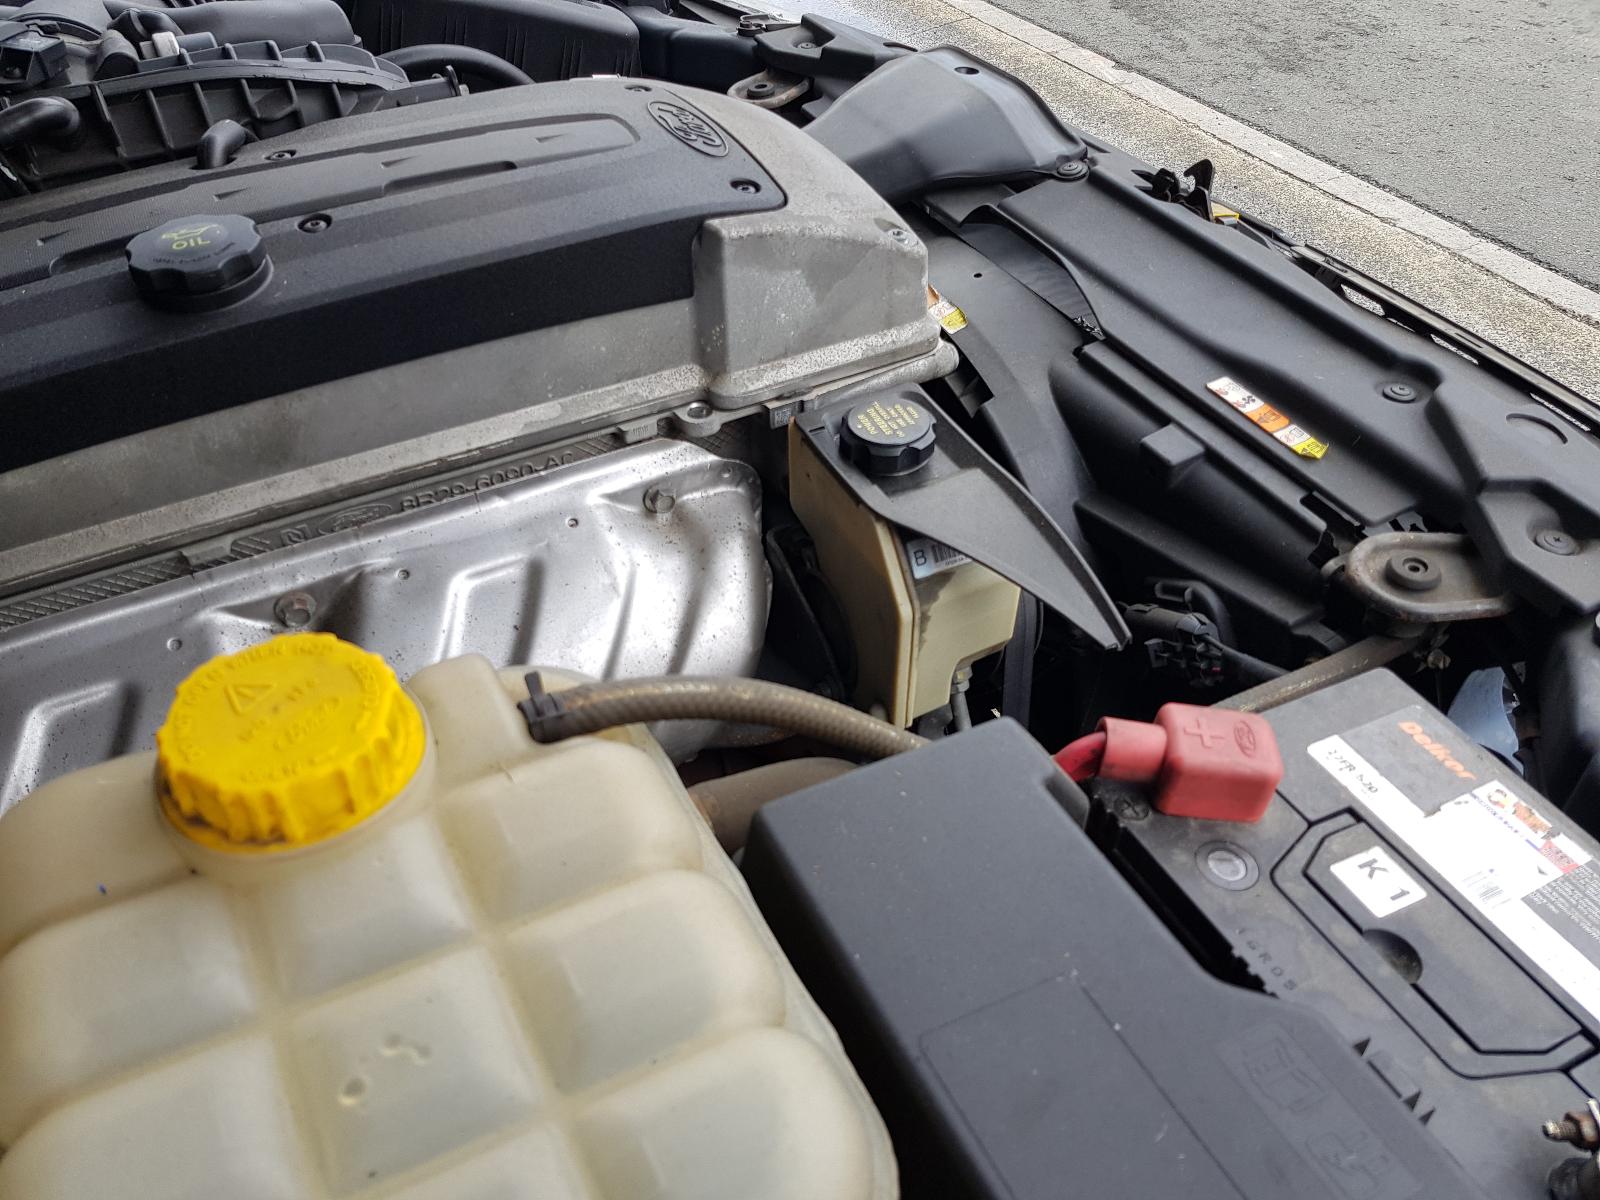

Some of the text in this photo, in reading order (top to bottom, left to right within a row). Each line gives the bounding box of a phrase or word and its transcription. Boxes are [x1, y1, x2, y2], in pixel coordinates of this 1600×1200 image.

[172, 235, 211, 250] OIL
[857, 414, 878, 435] POWER
[867, 408, 894, 435] STEERING
[913, 549, 927, 566] B
[1399, 721, 1476, 781] Delkor
[1358, 858, 1410, 901] K 1
